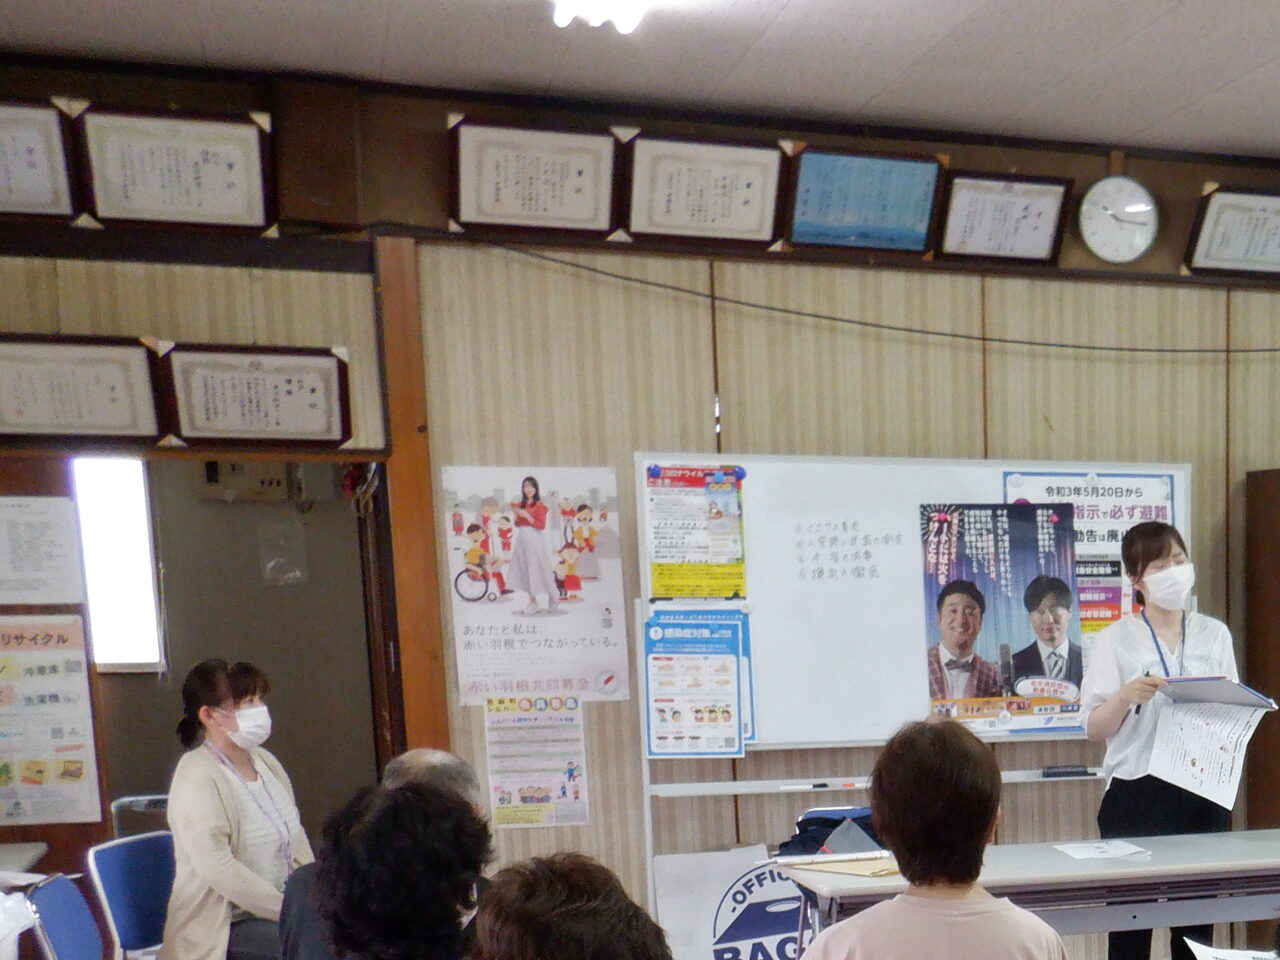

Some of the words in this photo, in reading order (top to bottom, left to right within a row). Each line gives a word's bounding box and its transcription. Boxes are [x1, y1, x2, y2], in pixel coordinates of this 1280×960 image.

[1045, 486, 1143, 497] 令和3年5月20日から
